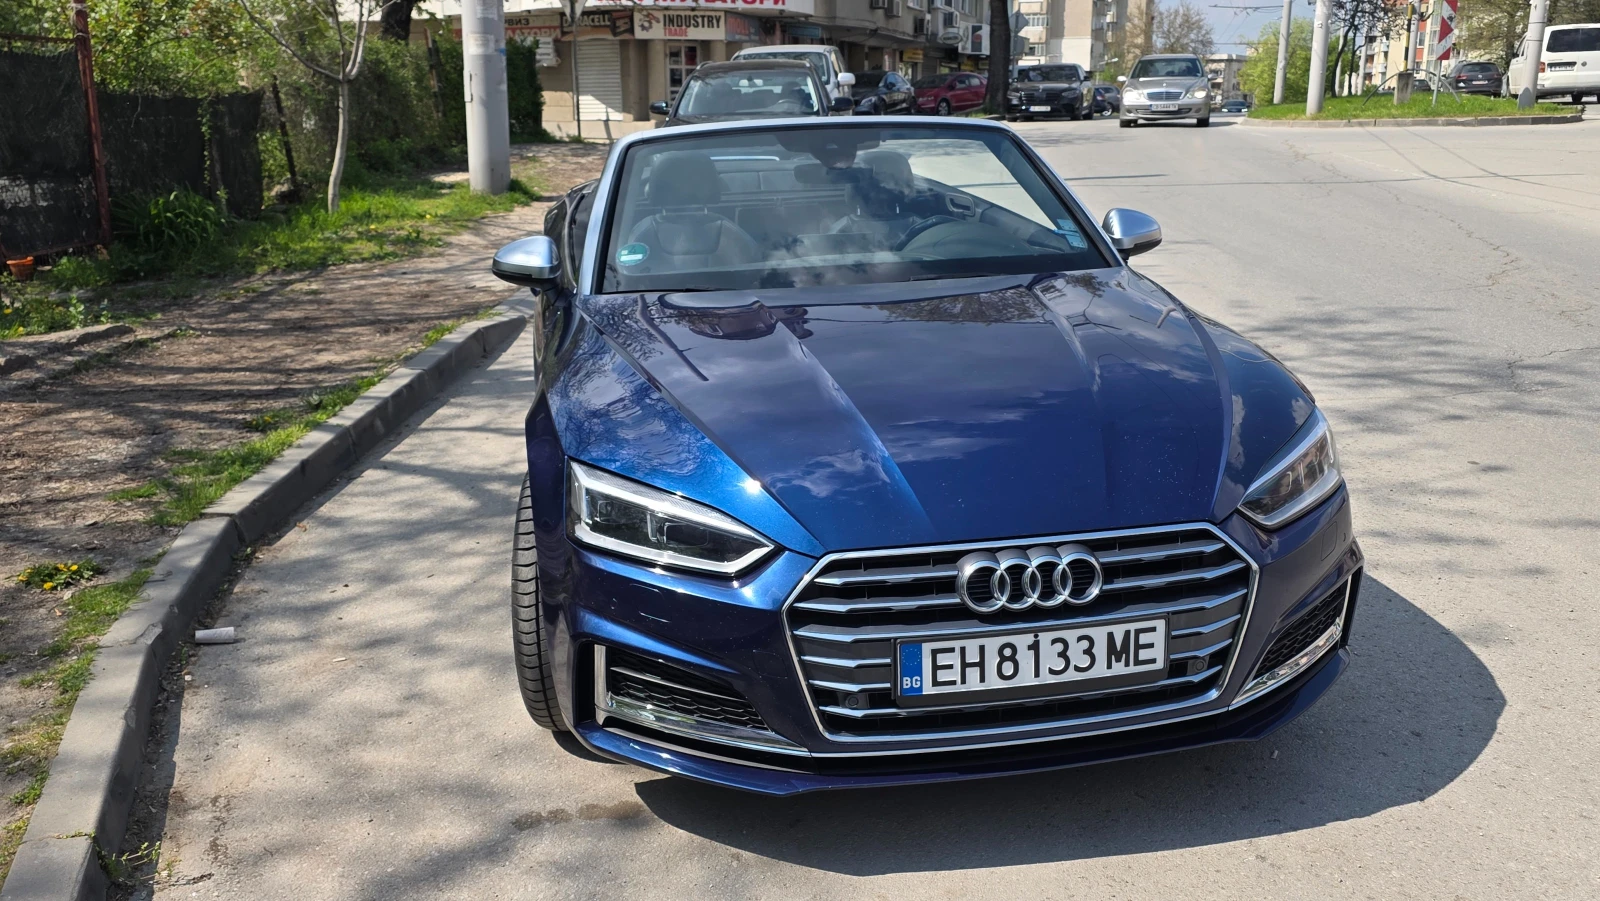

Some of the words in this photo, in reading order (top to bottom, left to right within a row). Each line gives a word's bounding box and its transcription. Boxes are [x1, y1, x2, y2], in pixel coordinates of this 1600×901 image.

[562, 14, 610, 26] DRACELL
[663, 14, 721, 28] INDUSTRY
[664, 28, 688, 37] TRADE
[930, 644, 986, 687] EH
[996, 635, 1097, 681] 8133
[1106, 626, 1157, 670] ME
[903, 676, 921, 689] BG
